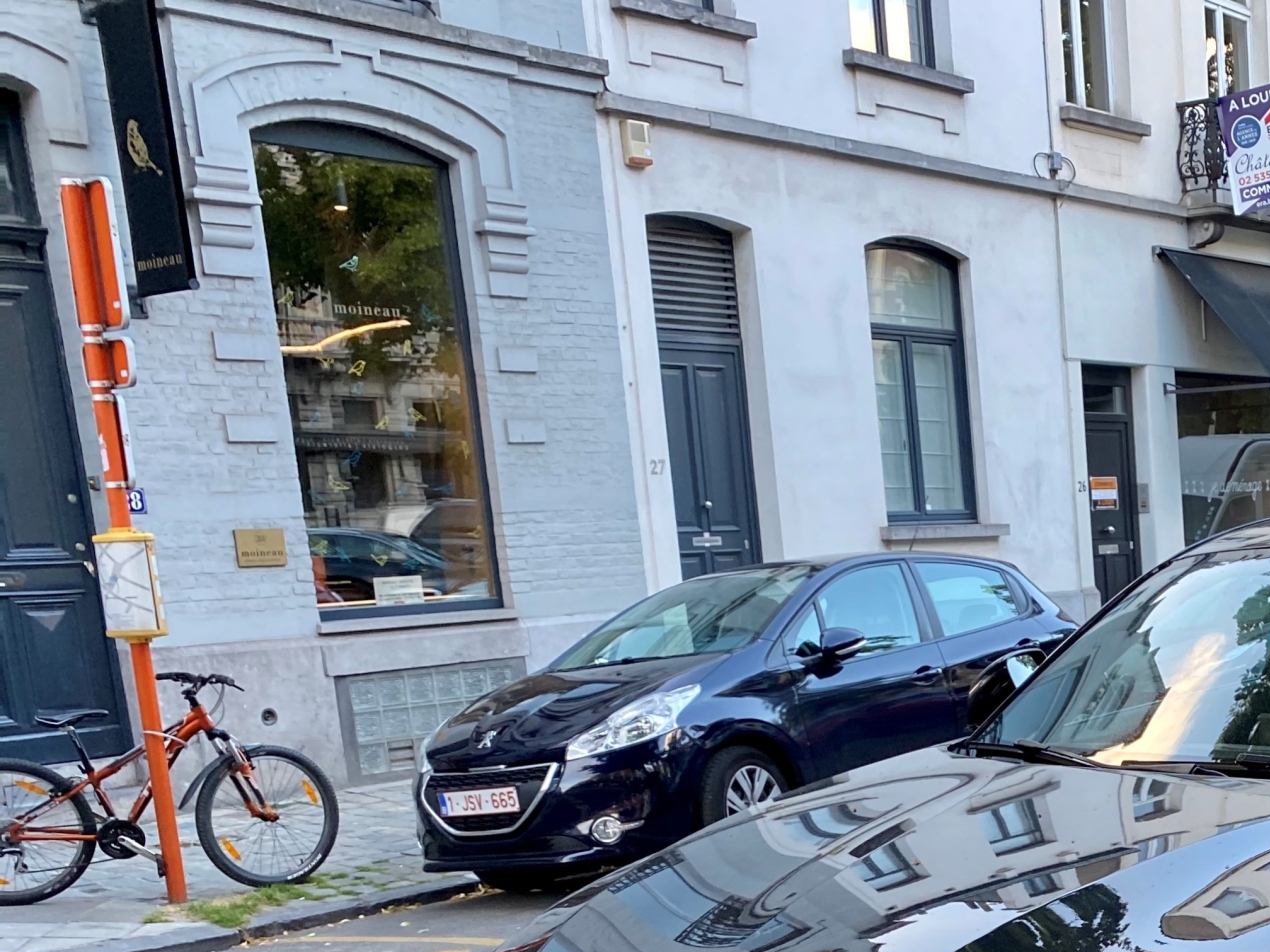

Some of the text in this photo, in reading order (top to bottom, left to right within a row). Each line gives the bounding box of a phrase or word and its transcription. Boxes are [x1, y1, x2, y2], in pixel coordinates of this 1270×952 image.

[1229, 99, 1239, 112] A
[1238, 175, 1252, 186] 02
[137, 253, 183, 272] moineau
[334, 301, 401, 318] moineau
[649, 459, 666, 475] 27
[1077, 480, 1087, 493] 26
[241, 549, 284, 557] moineau
